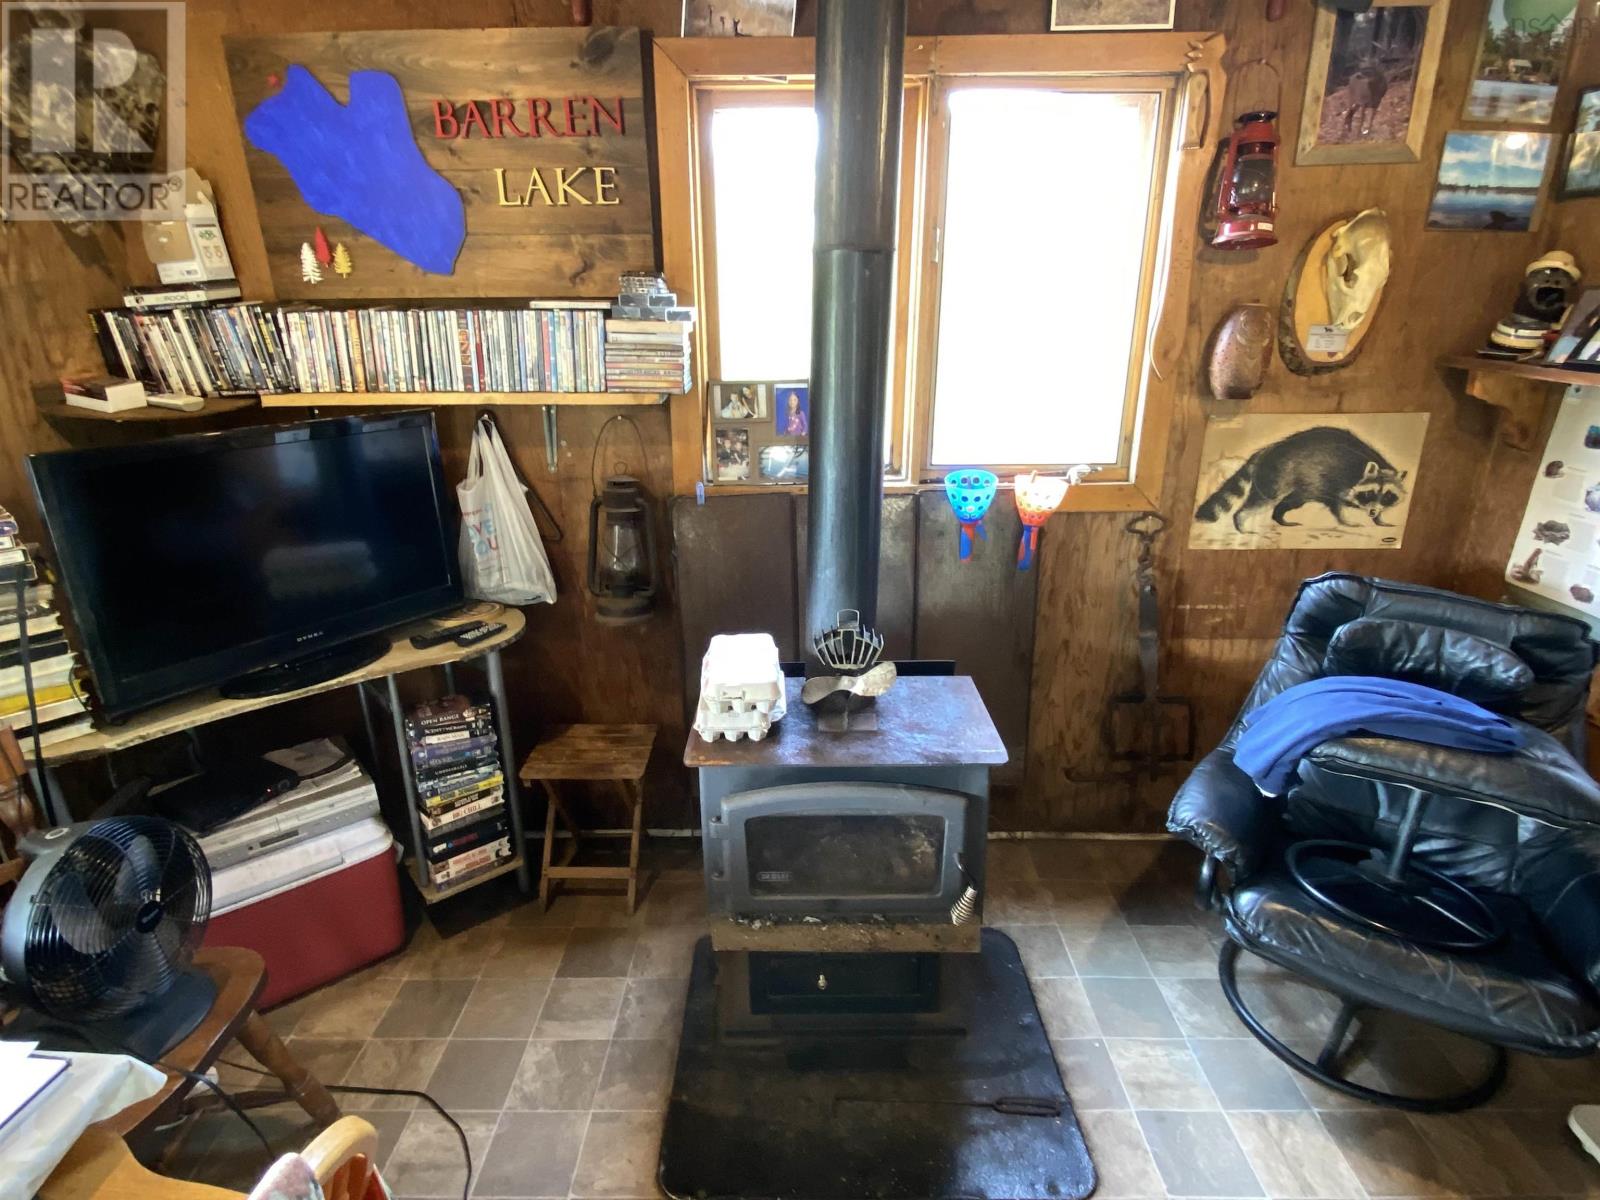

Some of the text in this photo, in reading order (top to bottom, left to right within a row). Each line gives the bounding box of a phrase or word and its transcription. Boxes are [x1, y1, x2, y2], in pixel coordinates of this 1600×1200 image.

[431, 95, 626, 139] BARREN
[494, 167, 619, 206] LAKE
[420, 713, 460, 726] OPEN RANGE
